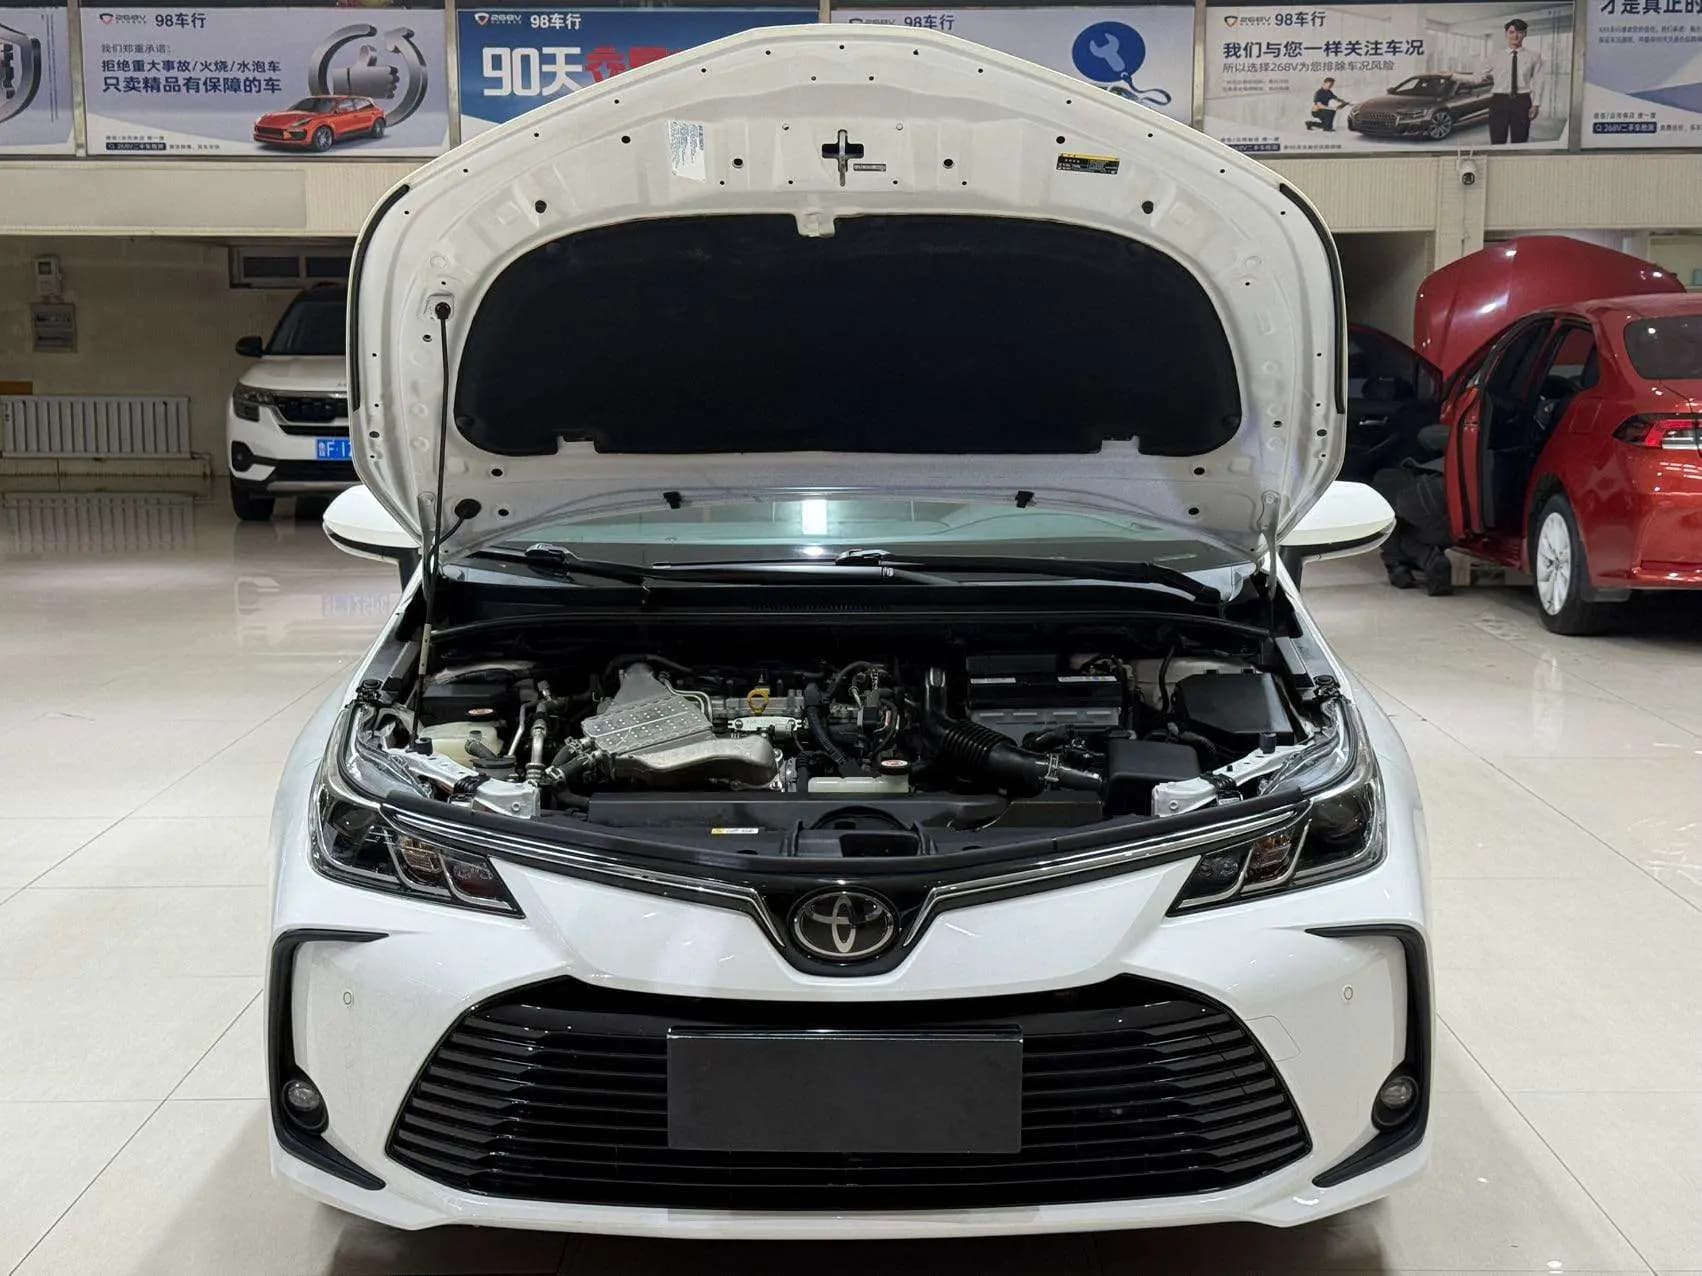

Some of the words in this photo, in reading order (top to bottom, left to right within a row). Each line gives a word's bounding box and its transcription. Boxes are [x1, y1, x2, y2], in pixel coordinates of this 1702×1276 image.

[155, 12, 207, 29] 98车行
[530, 13, 582, 30] 98车行
[904, 14, 955, 30] 98车行
[1275, 11, 1326, 28] 98车行
[1222, 39, 1426, 59] 我们与您一样关注车况
[101, 60, 282, 74] 拒绝重大事故/火烧/水泡车
[1222, 60, 1396, 74] 所以选择268V为您排除车况风险
[102, 76, 283, 94] 只卖精品有保障的车
